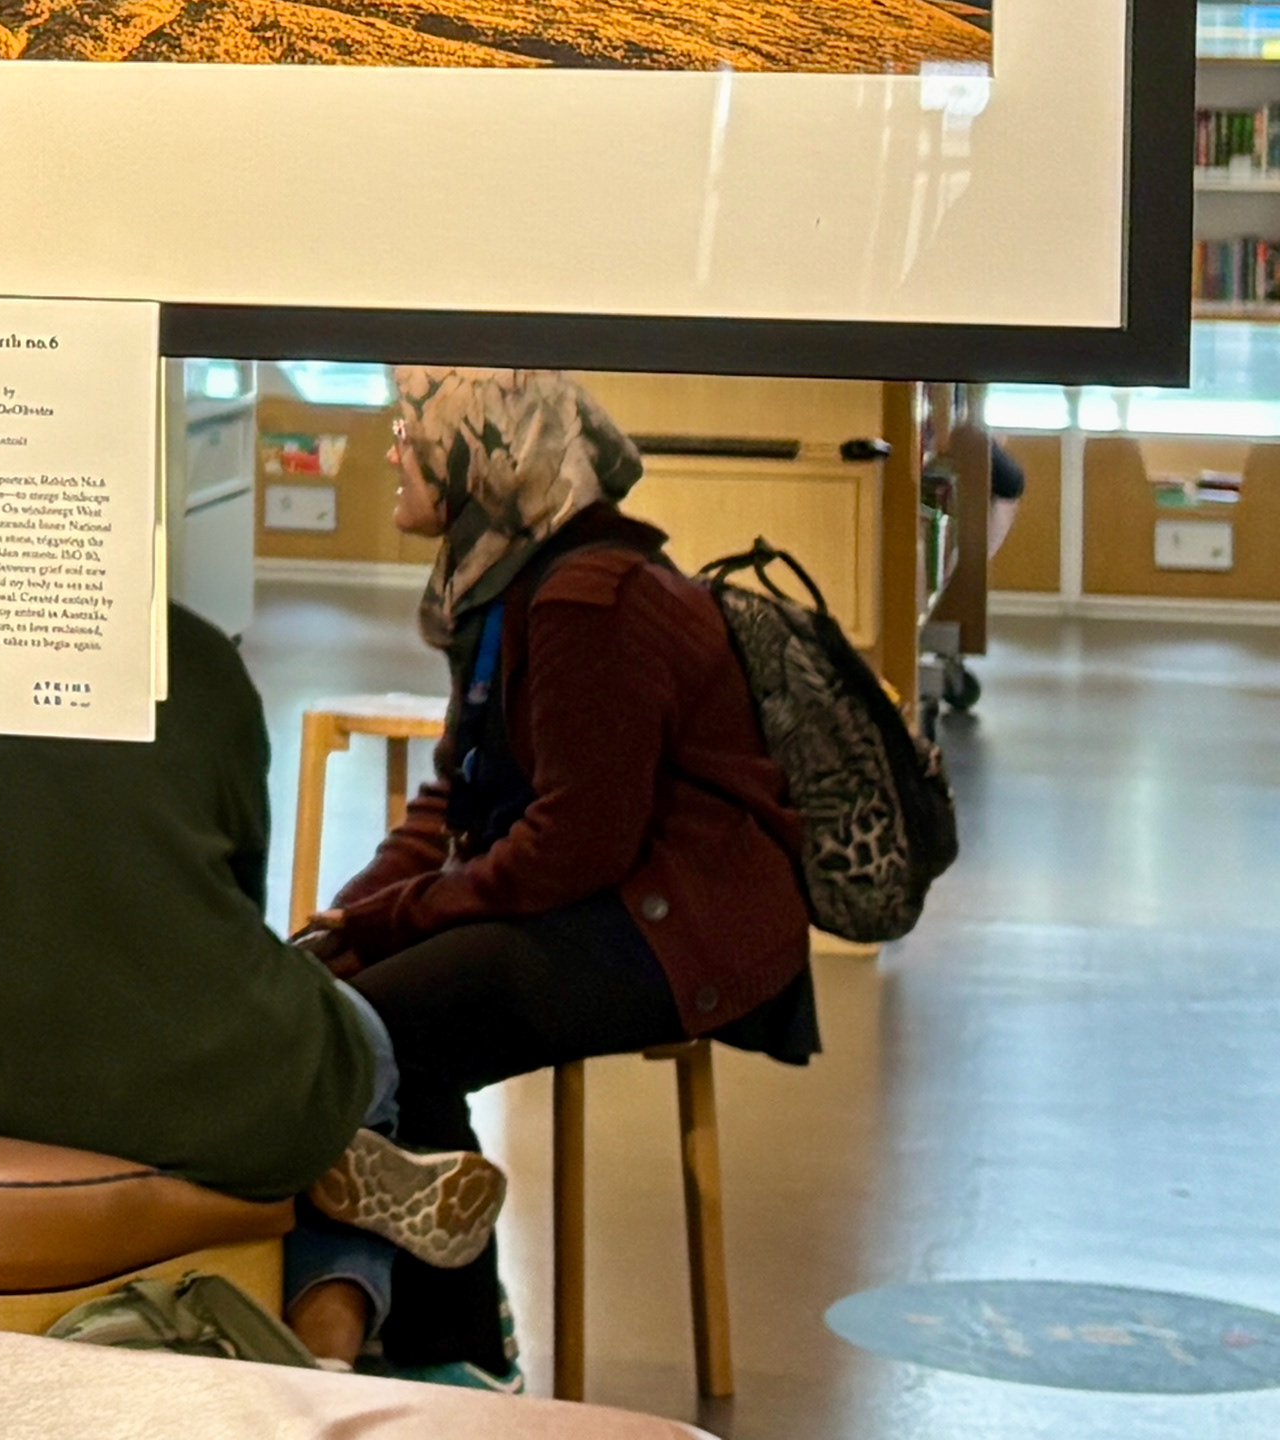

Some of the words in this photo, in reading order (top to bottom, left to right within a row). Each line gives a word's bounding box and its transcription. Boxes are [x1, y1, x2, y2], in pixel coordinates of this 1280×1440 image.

[3, 386, 15, 399] by
[33, 681, 91, 693] ATKINS
[33, 695, 62, 706] LAB
